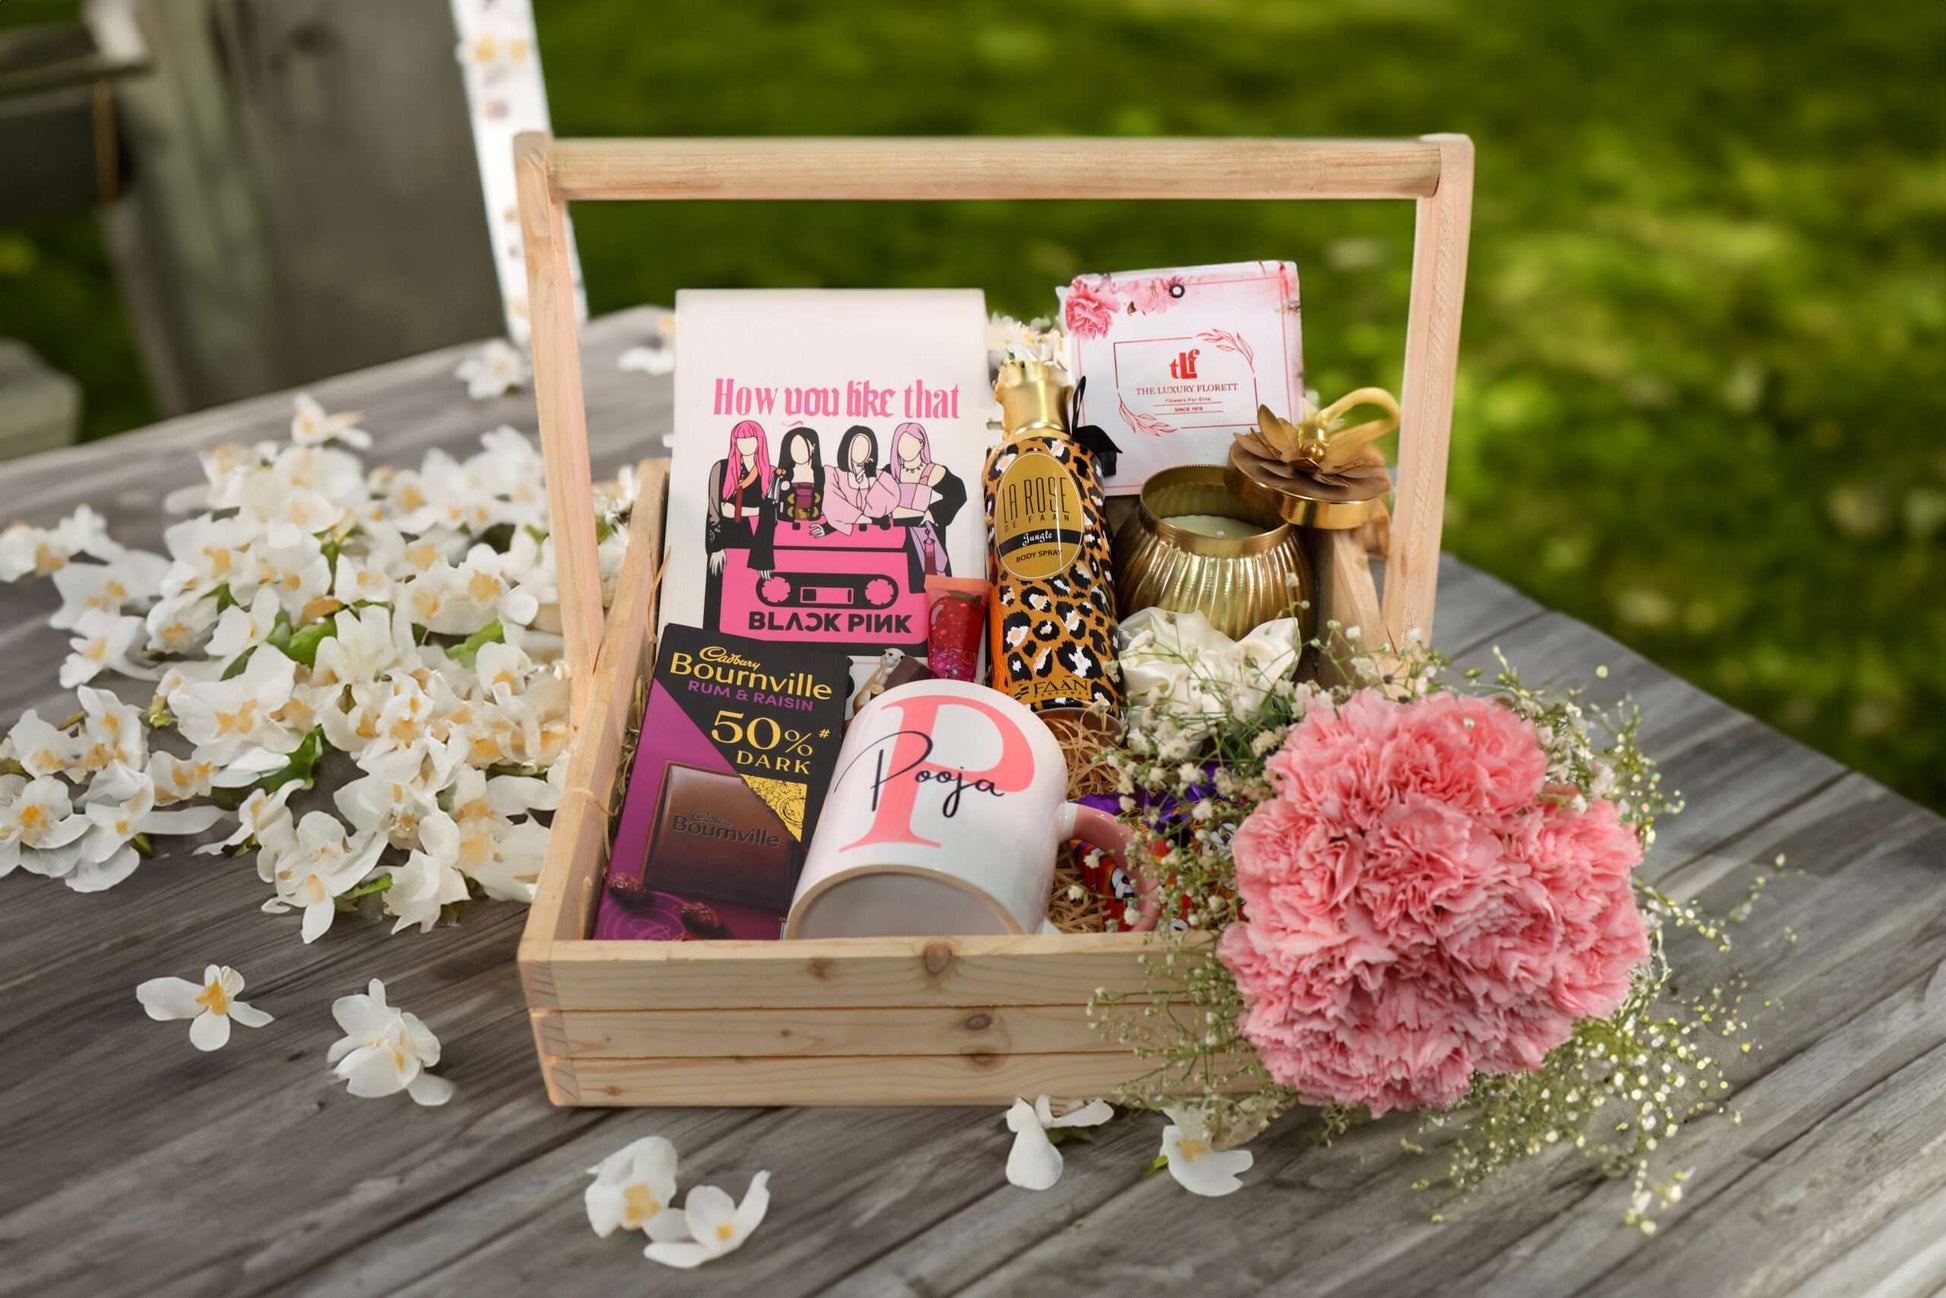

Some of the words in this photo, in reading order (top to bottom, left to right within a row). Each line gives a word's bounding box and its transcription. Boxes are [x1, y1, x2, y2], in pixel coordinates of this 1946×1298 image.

[713, 378, 778, 416] How
[782, 386, 840, 427] you
[846, 379, 896, 418] like
[903, 379, 960, 419] that
[1136, 387, 1156, 396] THE
[1158, 384, 1195, 395] LUXURY
[1196, 382, 1239, 393] FLORETT
[1002, 483, 1018, 524] LA
[1024, 476, 1070, 515] ROSE
[1004, 520, 1017, 532] DE
[1028, 513, 1070, 524] FAAN
[1022, 529, 1053, 547] Jungle
[1016, 550, 1037, 563] BODY
[699, 645, 761, 671] Cadbury
[669, 651, 833, 701] Bournville
[688, 679, 731, 698] RUM
[735, 689, 749, 702] &
[753, 691, 814, 712] RAISIN
[736, 749, 811, 775] DARK
[834, 730, 1005, 818] Pooja
[839, 694, 1035, 854] P
[673, 814, 781, 848] Bournville
